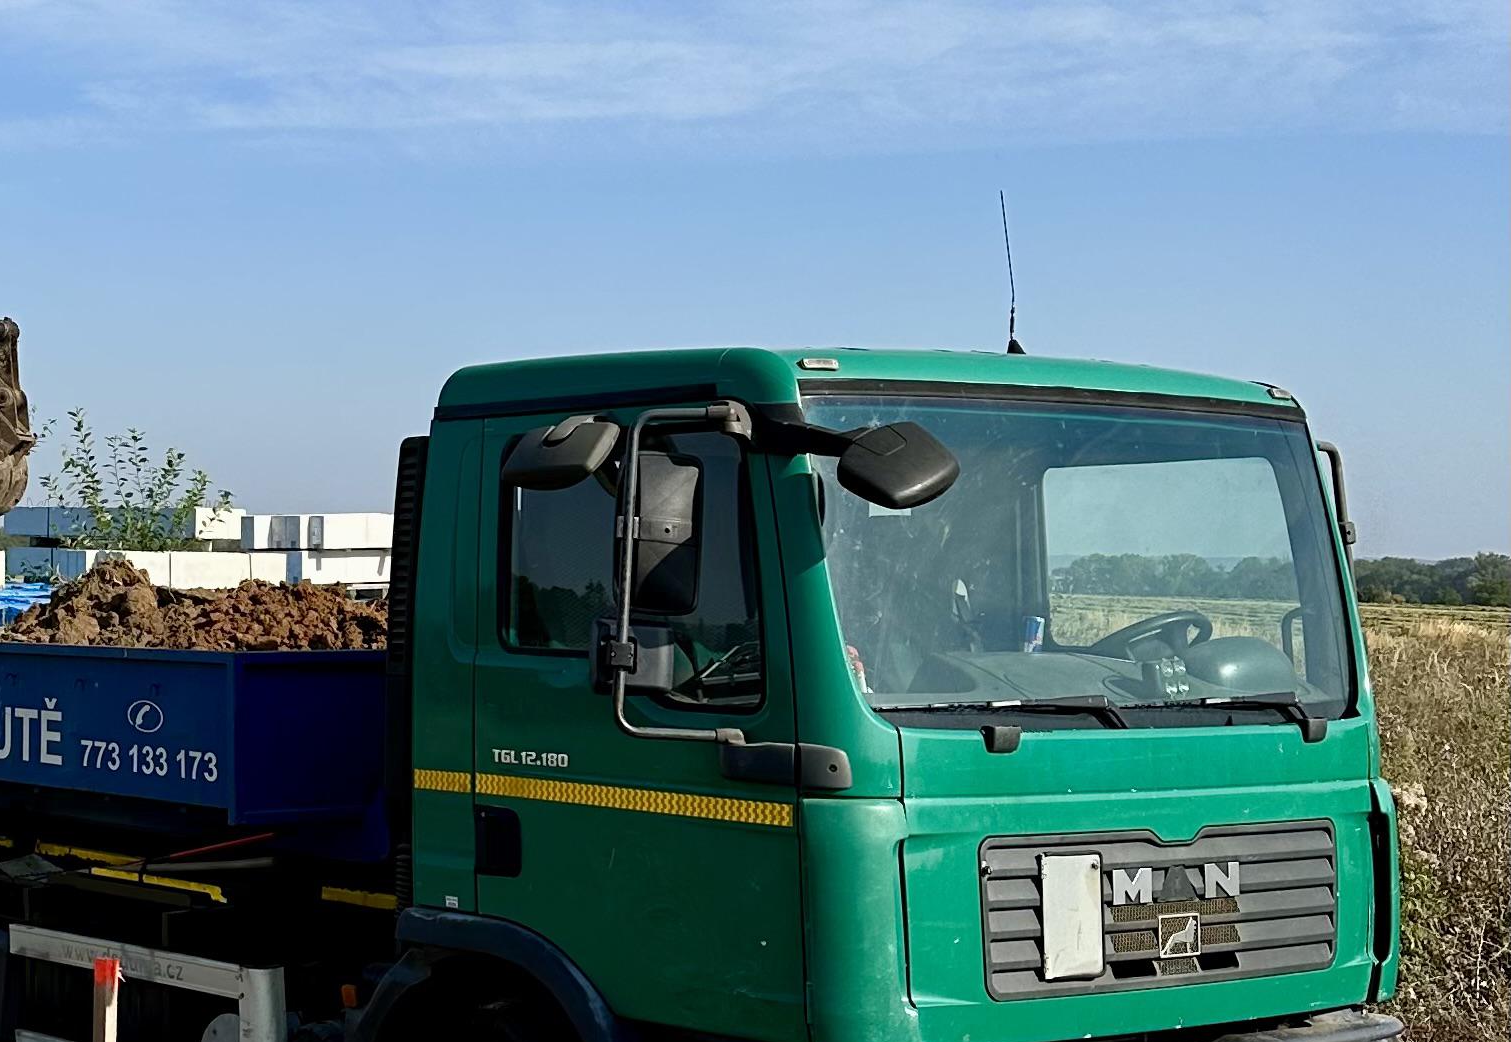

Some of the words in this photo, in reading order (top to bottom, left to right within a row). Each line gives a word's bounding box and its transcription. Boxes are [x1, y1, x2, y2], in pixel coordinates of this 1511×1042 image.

[80, 739, 122, 772] 773
[128, 744, 169, 777] 133
[176, 749, 219, 783] 173
[491, 748, 520, 765] TGL
[520, 751, 570, 768] 12.180
[1112, 861, 1240, 906] MAN
